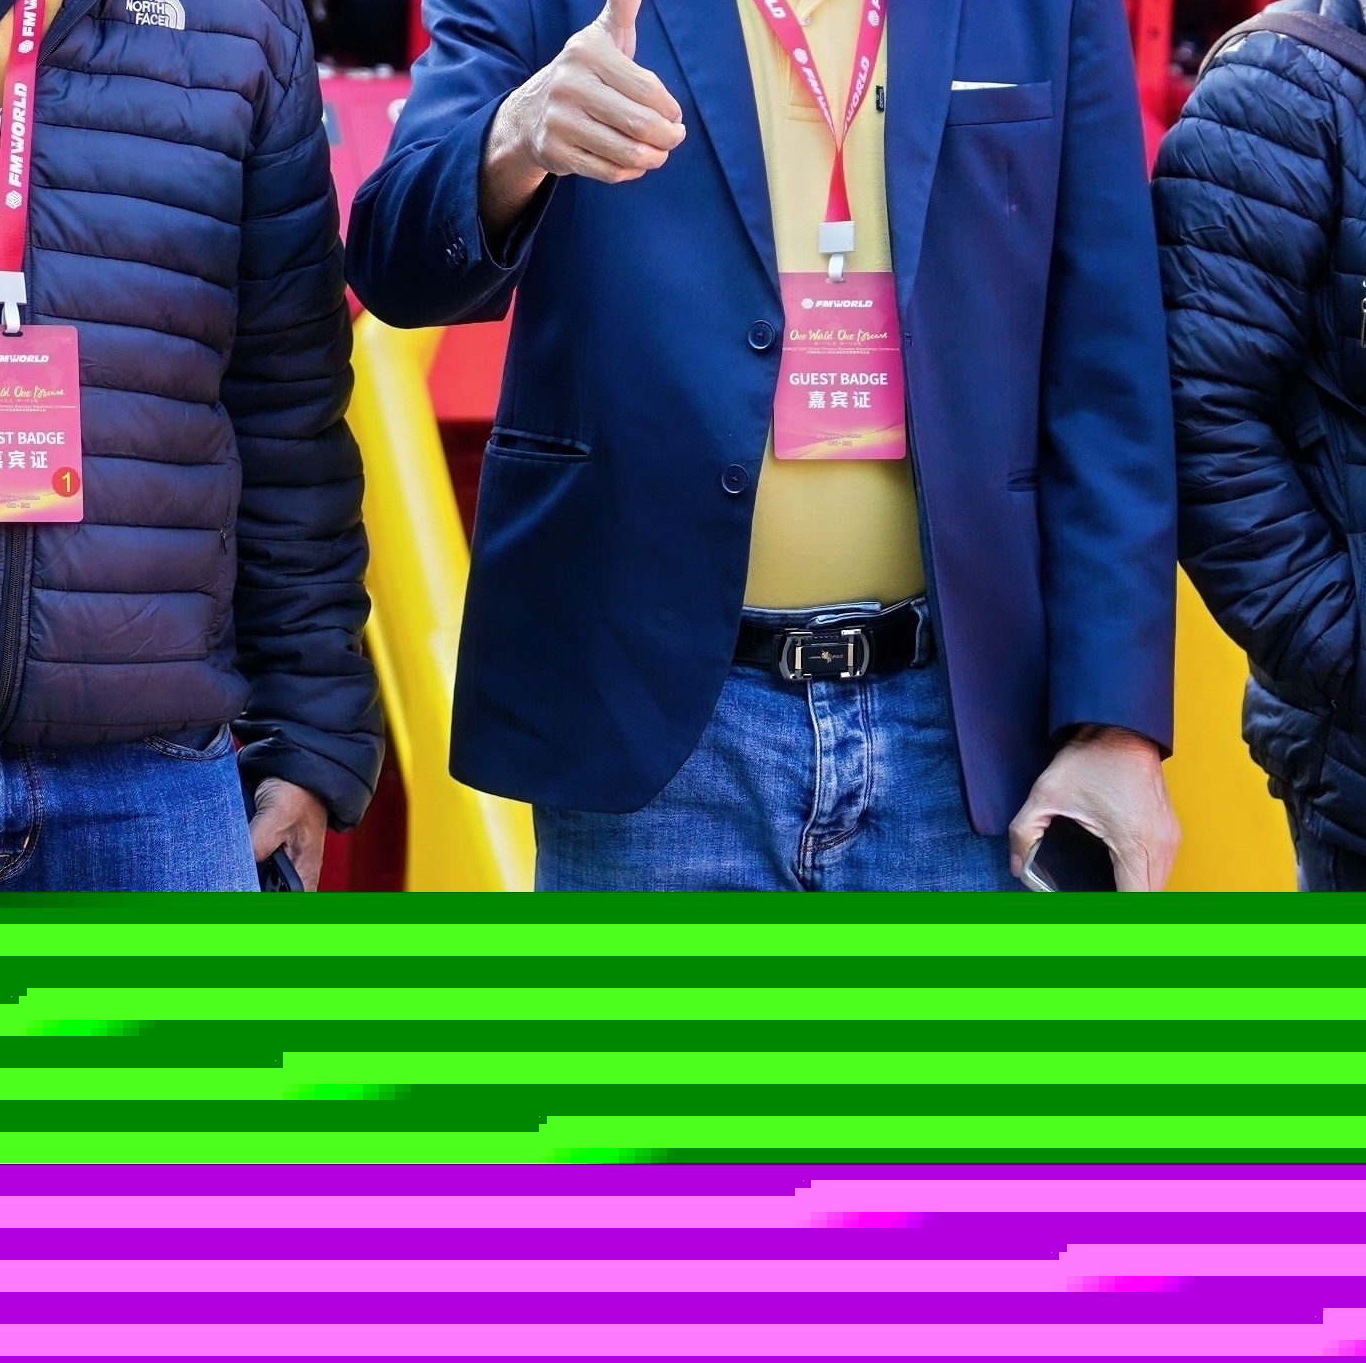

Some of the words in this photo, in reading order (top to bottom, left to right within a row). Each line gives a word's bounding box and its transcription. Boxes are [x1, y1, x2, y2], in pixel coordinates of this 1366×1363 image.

[136, 13, 165, 26] FACE
[9, 82, 28, 187] FMWORLD
[816, 299, 873, 308] FMWORLD
[789, 329, 807, 340] One
[809, 329, 834, 340] World
[837, 329, 855, 340] One
[789, 372, 837, 386] GUEST
[840, 372, 888, 386] BADGE
[14, 385, 31, 397] One
[808, 390, 871, 409] 嘉宾证
[18, 431, 66, 445] BADGE
[61, 471, 71, 493] 1
